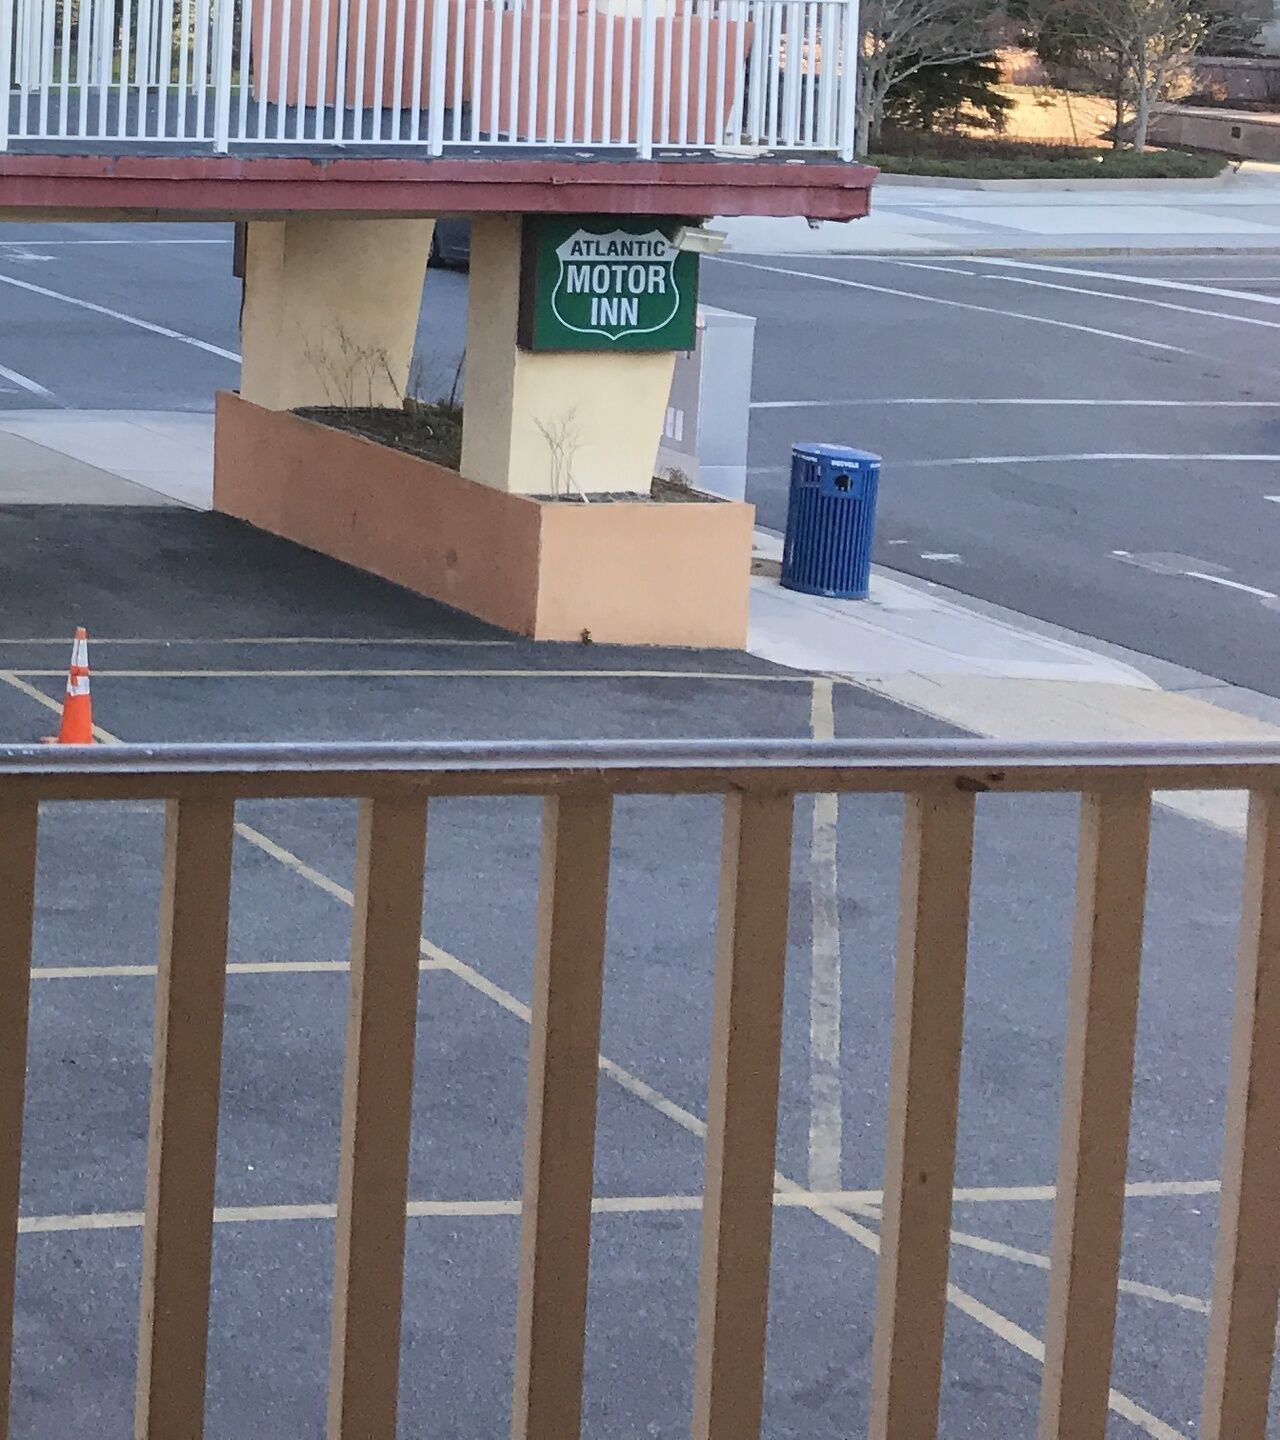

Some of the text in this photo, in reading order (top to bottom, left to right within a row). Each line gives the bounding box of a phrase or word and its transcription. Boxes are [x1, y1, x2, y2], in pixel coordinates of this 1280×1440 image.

[570, 240, 666, 257] ATLANTIC
[566, 264, 666, 294] MOTOR
[591, 297, 639, 326] INN
